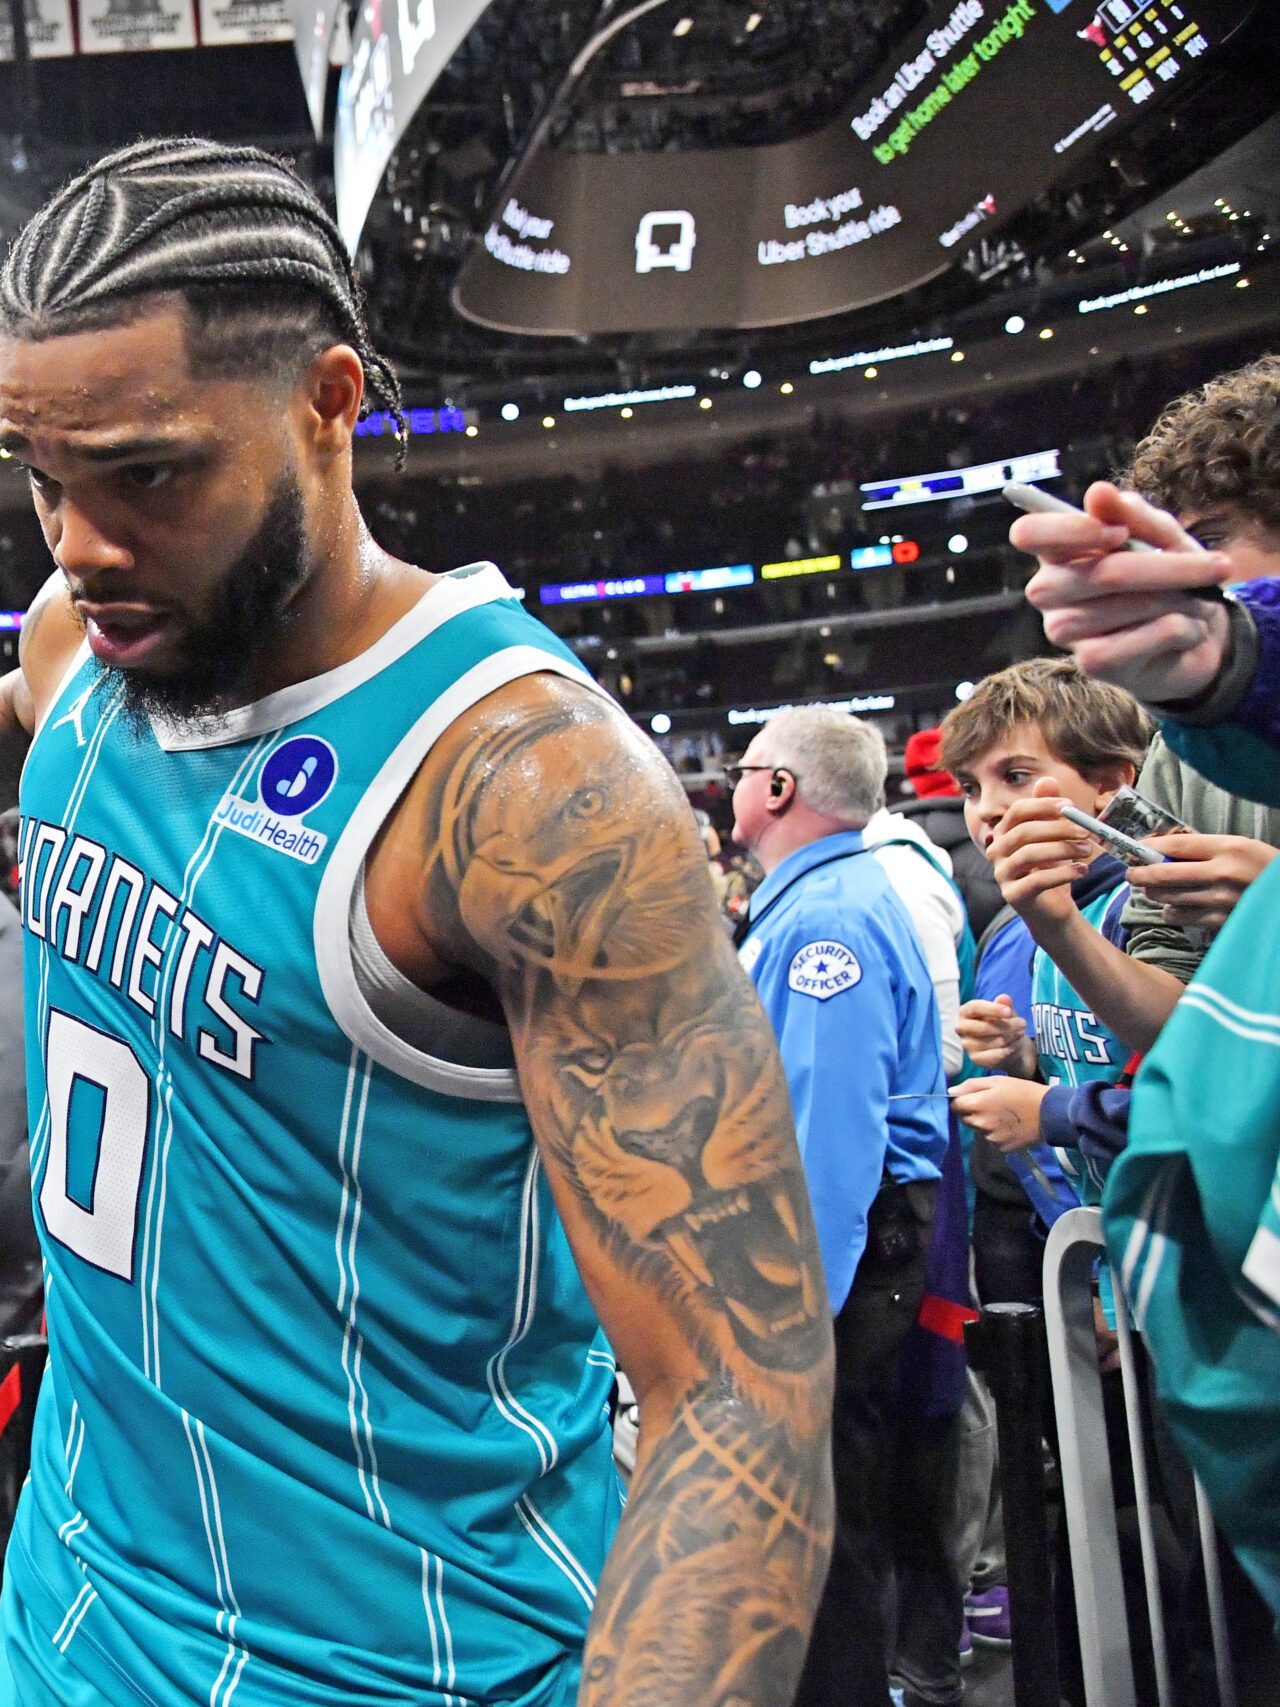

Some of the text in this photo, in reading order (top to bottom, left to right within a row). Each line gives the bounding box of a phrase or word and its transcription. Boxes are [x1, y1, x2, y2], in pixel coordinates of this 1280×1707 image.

[851, 0, 984, 141] Book an Uber Shuttle
[872, 0, 1037, 165] to get home later tonight
[758, 205, 902, 265] Uber Shuttle ride
[784, 197, 831, 229] Book
[217, 800, 320, 861] Judi Health
[18, 815, 274, 1081] HORNETS
[793, 945, 855, 970] SECURITY
[796, 970, 852, 990] OFFICER
[1031, 1003, 1114, 1065] RNETS
[39, 1005, 152, 1286] 0
